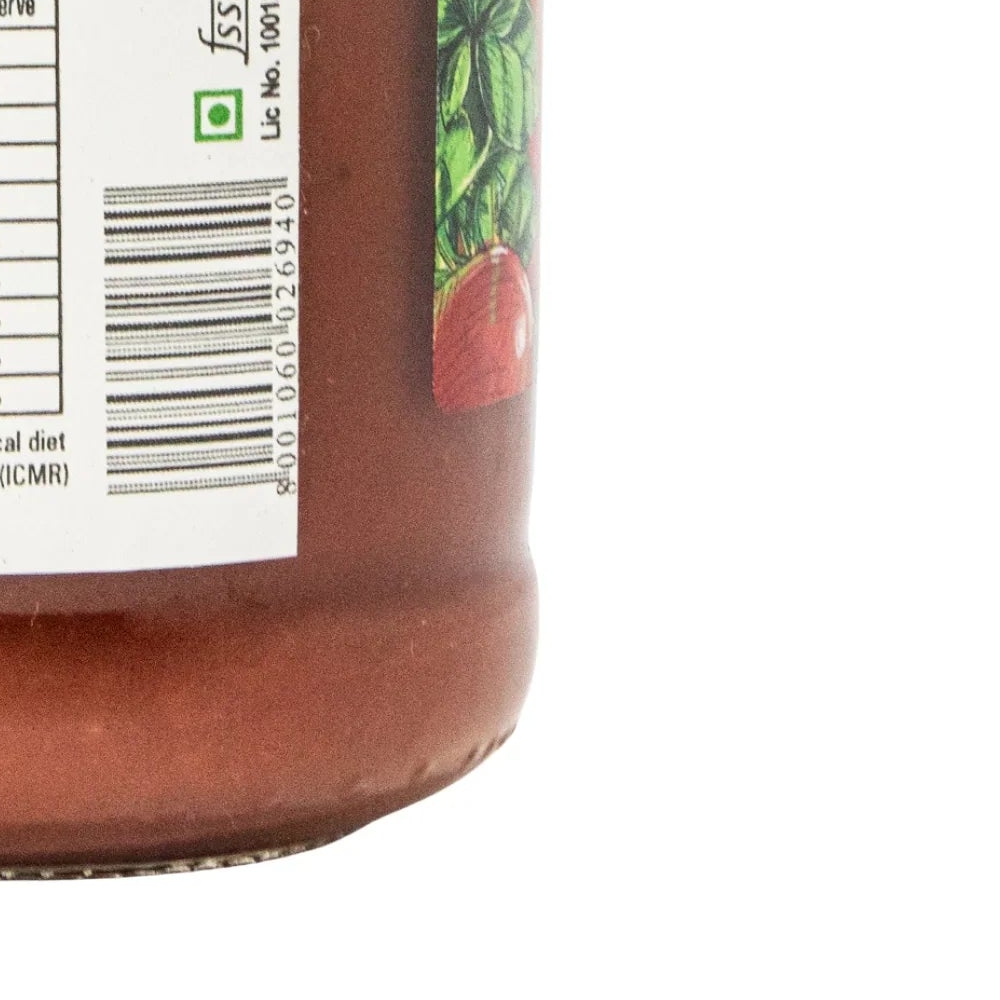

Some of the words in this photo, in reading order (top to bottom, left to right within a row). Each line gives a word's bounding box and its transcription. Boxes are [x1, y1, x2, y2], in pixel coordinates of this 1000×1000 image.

[261, 59, 281, 99] No.
[260, 106, 281, 141] Lic
[28, 429, 66, 452] diet
